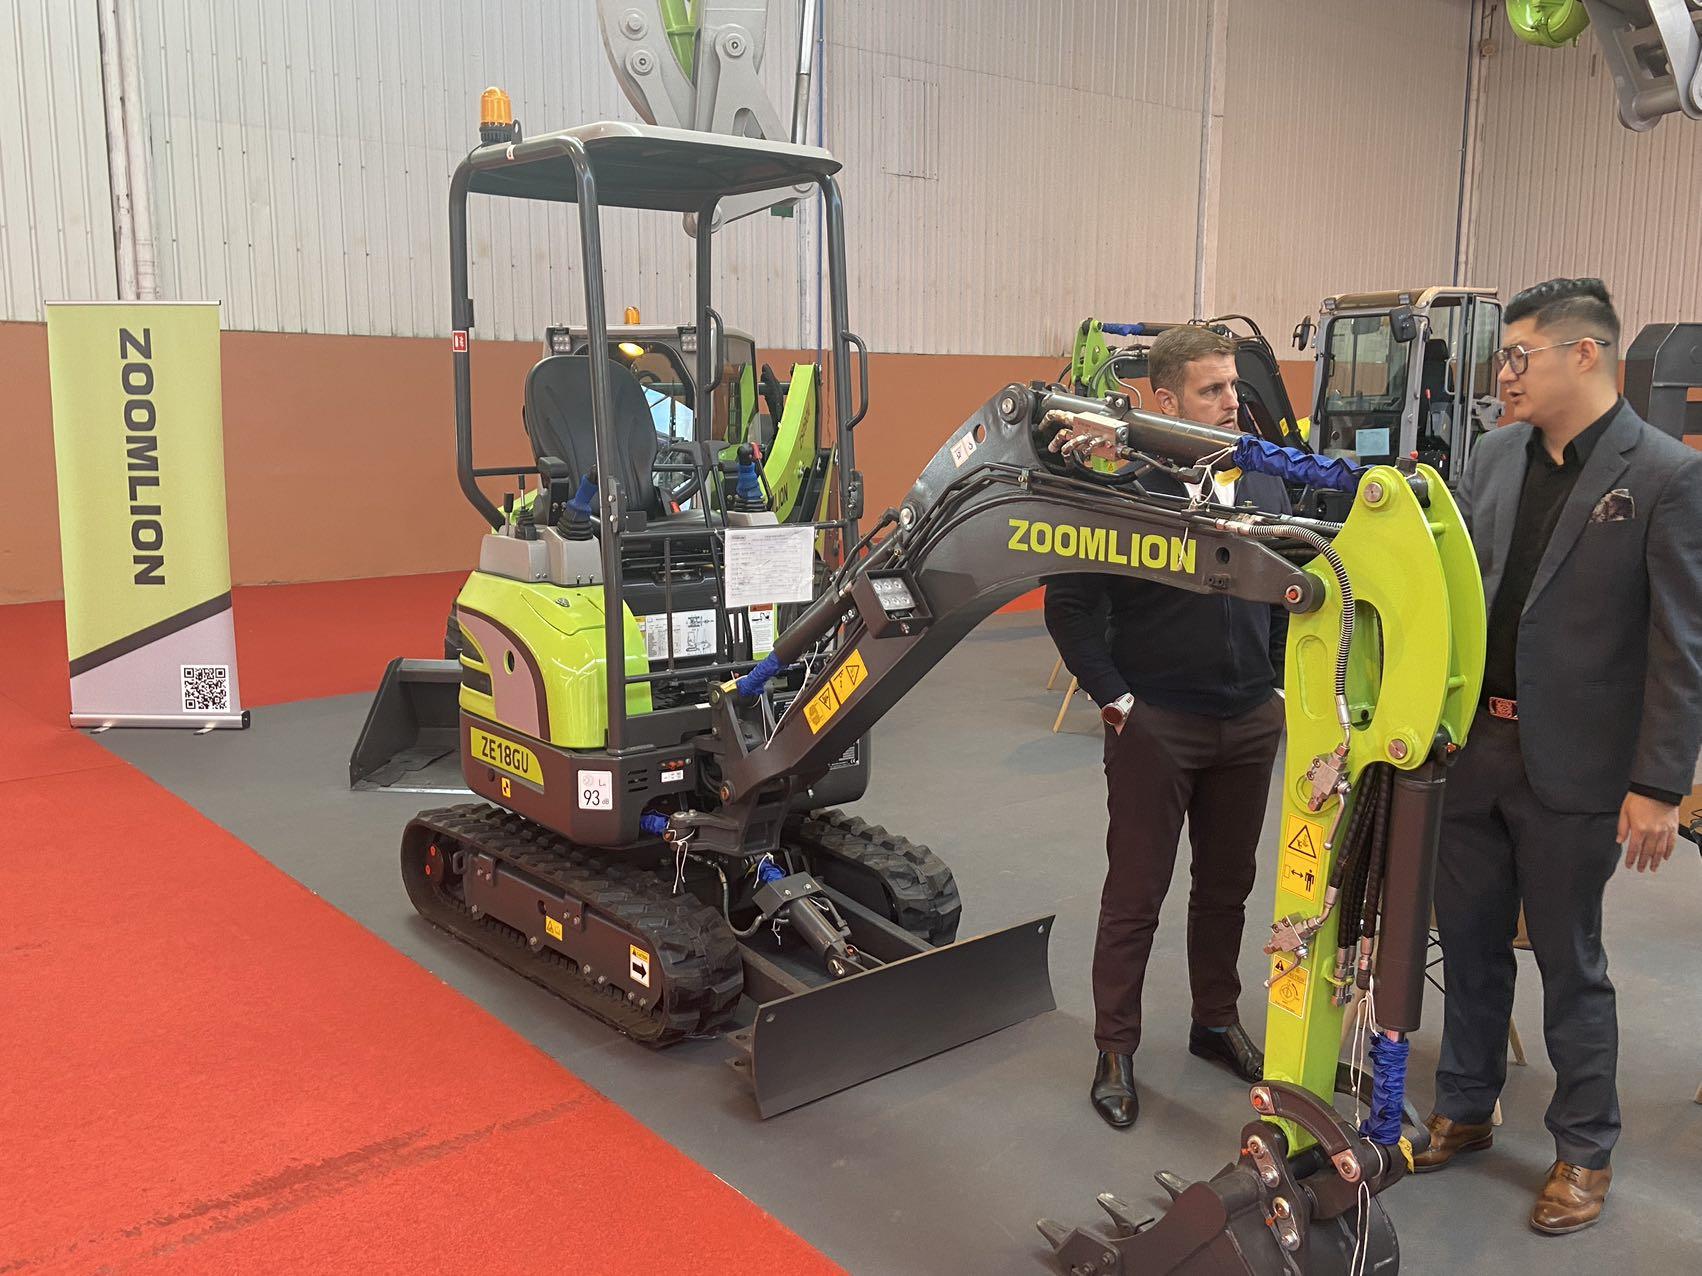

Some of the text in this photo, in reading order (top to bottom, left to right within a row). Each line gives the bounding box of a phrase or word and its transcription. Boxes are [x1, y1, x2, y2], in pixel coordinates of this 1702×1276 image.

[119, 327, 166, 586] ZOOMLION
[1007, 518, 1197, 574] ZOOMLION
[481, 735, 529, 774] ZE18GU
[583, 789, 600, 806] 93
